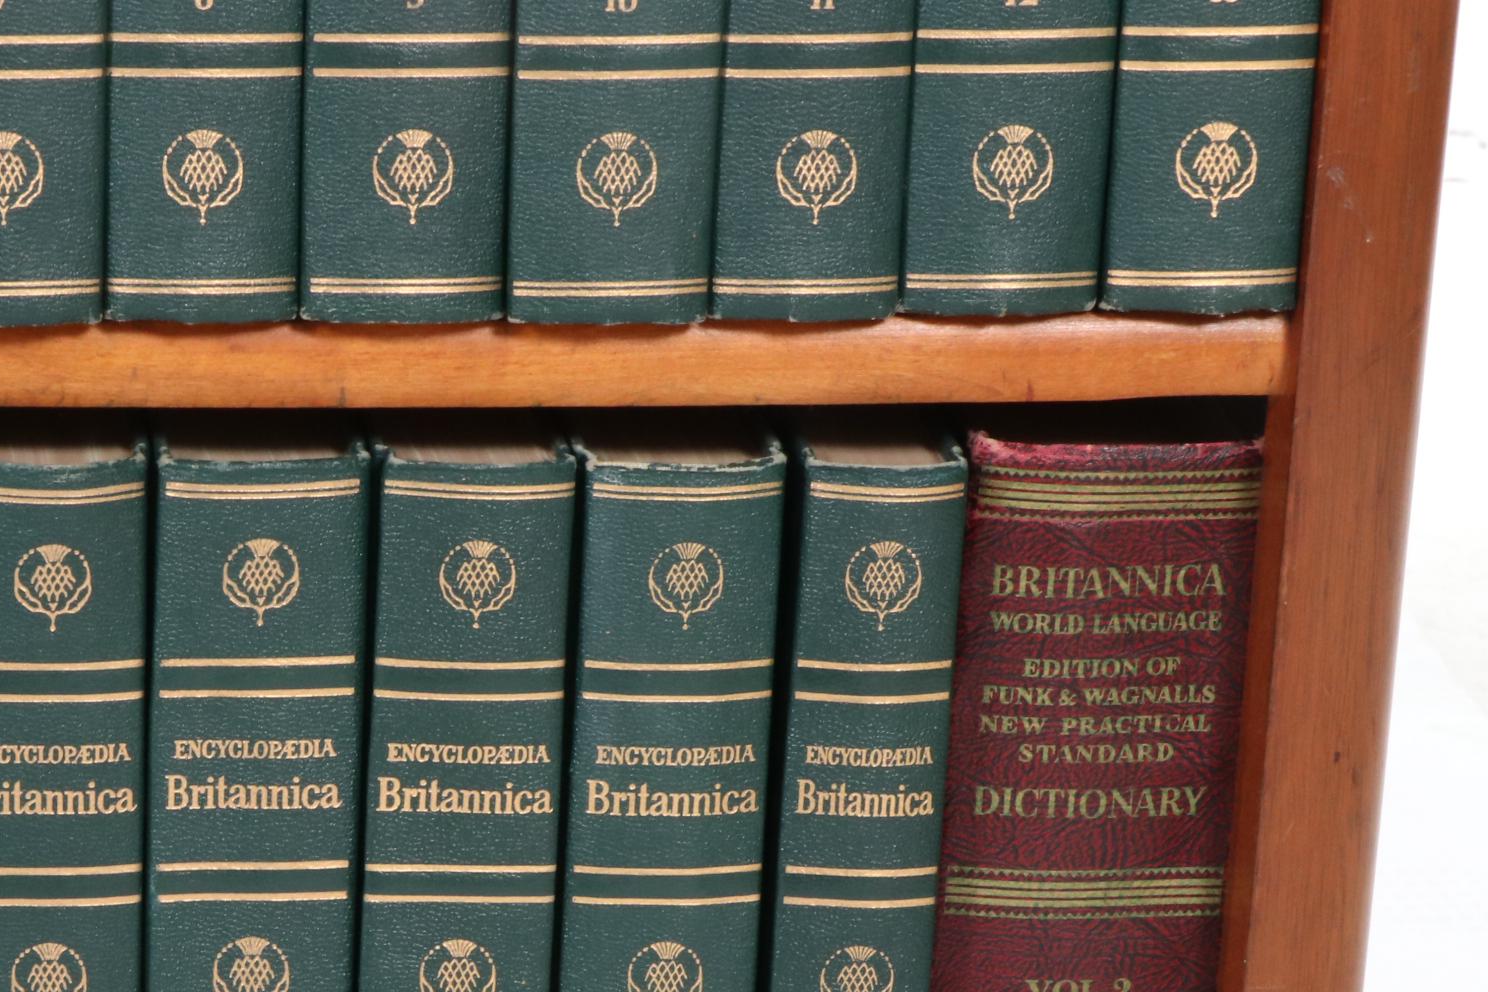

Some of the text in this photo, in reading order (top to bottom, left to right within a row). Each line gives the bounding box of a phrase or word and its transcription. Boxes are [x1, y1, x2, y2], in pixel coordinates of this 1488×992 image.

[989, 563, 1226, 600] BRITANNICA
[989, 611, 1223, 635] WORLD LANGUAGE
[1022, 656, 1181, 679] EDITION OF
[982, 684, 1216, 706] FUNK & WAGNALLS
[979, 714, 1211, 736] NEW PRACTICAL
[1018, 742, 1175, 764] STANDARD
[165, 775, 343, 810] Britannica
[375, 777, 553, 814] Britannica
[585, 779, 759, 817] Britannica
[795, 779, 934, 817] Britannica
[973, 786, 1208, 819] DICTIONARY
